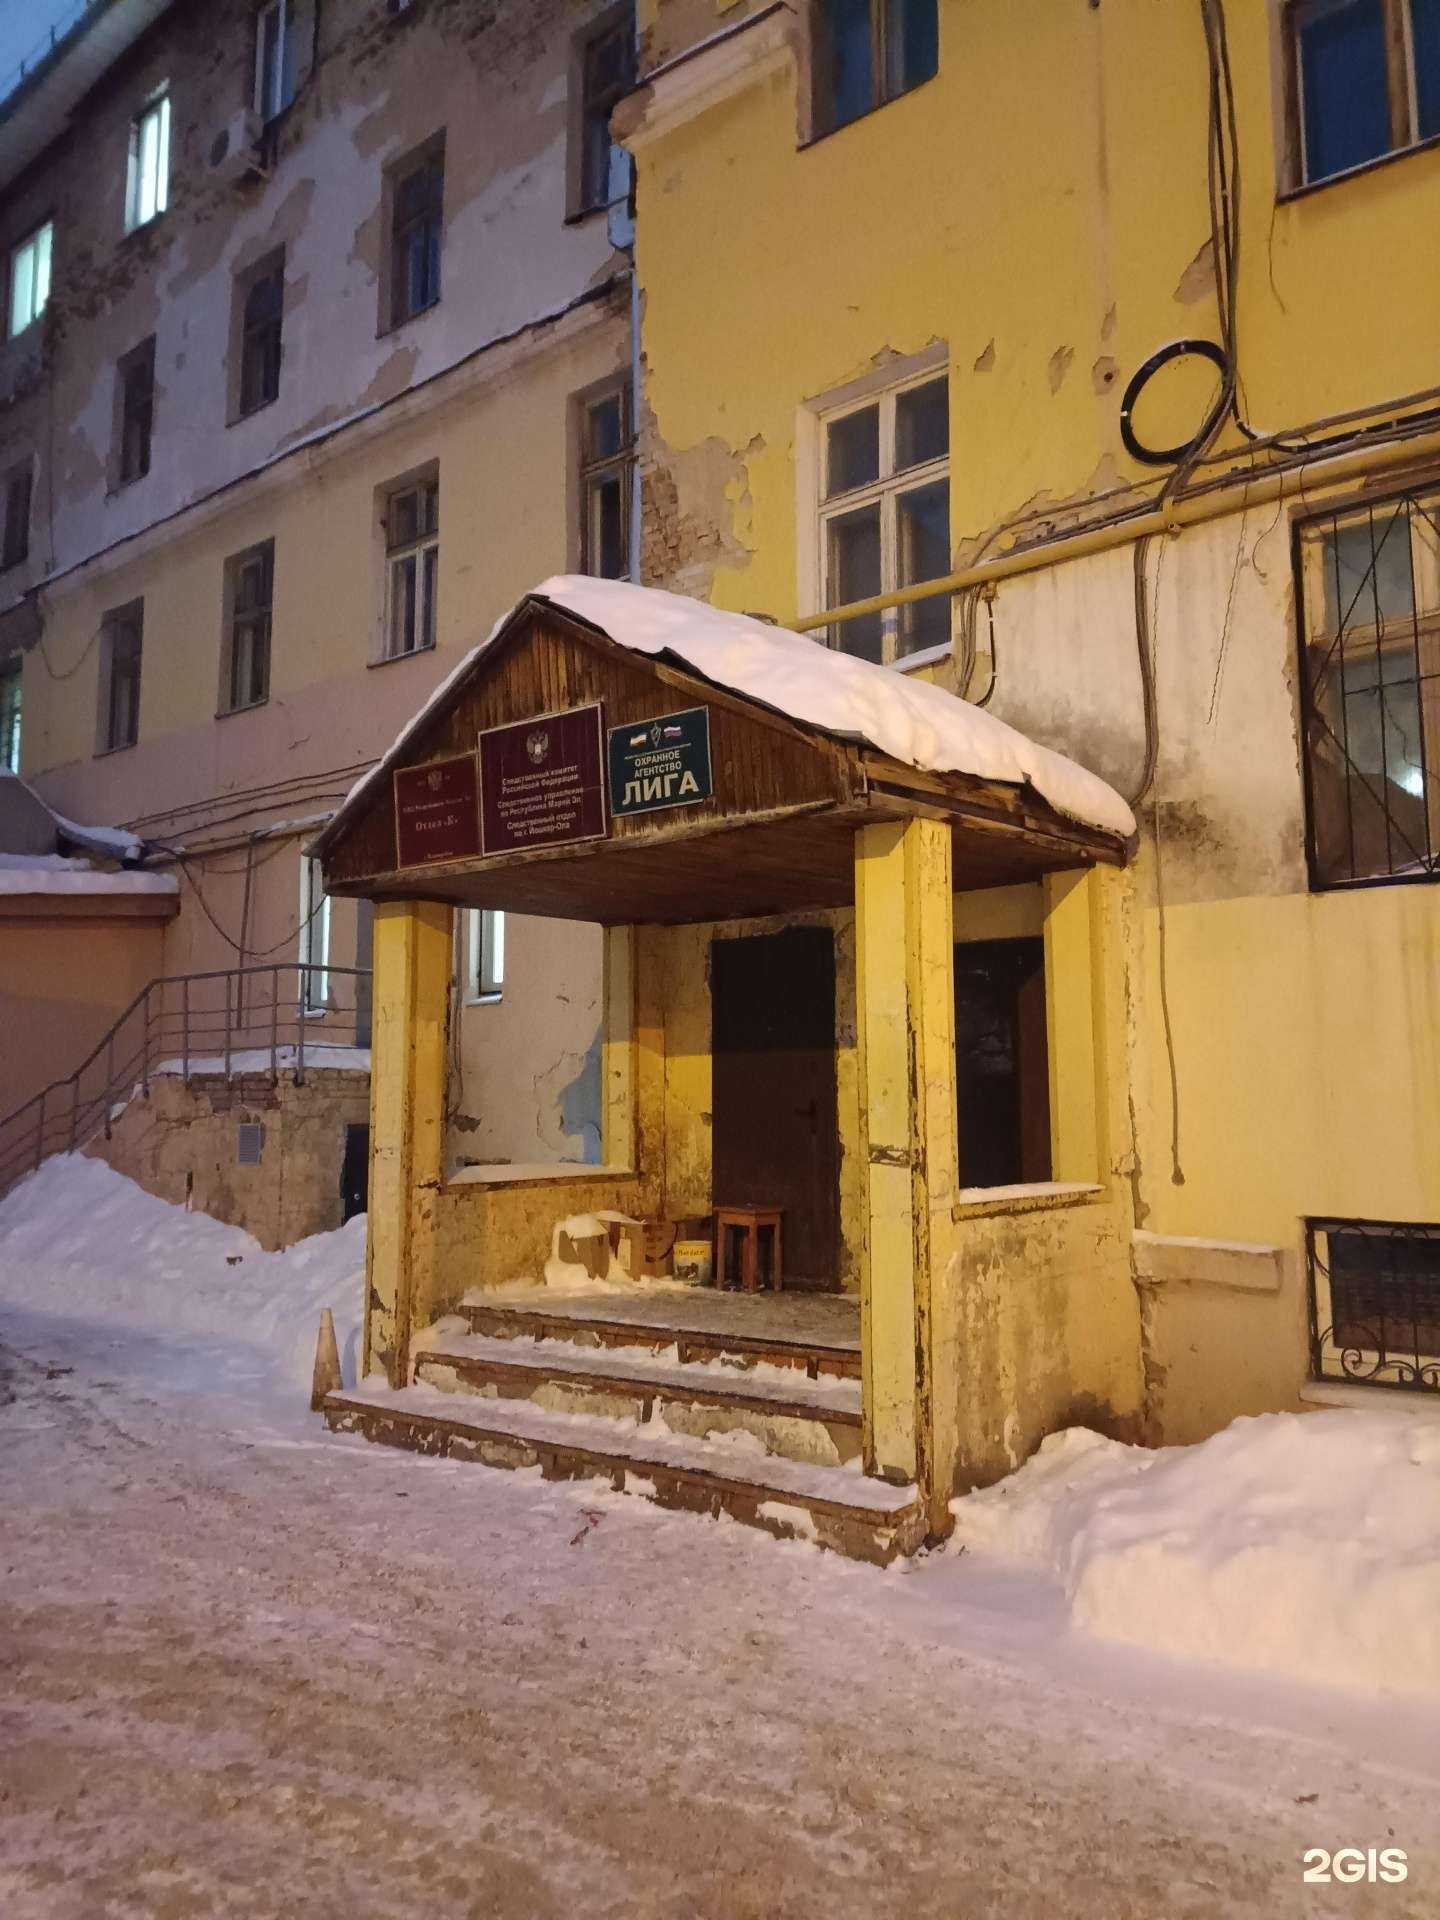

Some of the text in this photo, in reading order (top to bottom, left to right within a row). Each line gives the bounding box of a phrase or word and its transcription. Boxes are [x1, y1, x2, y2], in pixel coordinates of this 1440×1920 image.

[634, 750, 681, 767] ОХРАННОЕ
[634, 761, 682, 779] АГЕНТСТВО
[622, 770, 700, 805] ЛИГА
